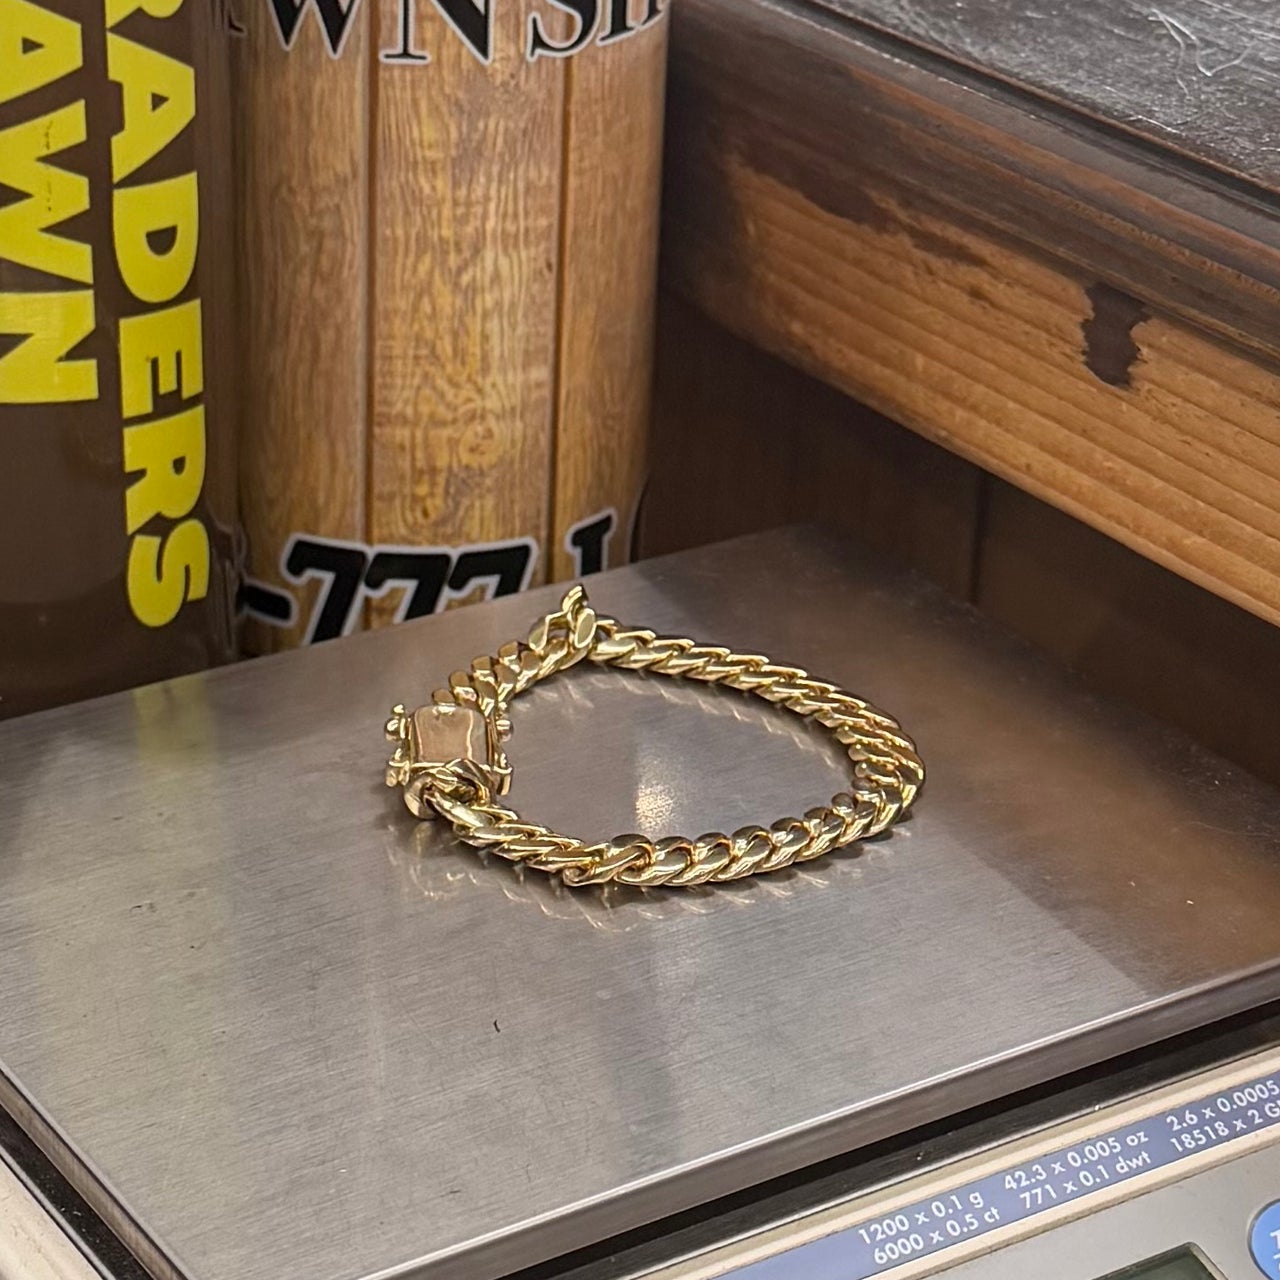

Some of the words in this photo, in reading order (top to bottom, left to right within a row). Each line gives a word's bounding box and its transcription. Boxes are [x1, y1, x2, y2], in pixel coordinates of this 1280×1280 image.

[858, 1214, 910, 1245] 1200
[915, 1211, 930, 1225] x
[931, 1195, 963, 1218] 0.1
[969, 1191, 984, 1208] g
[1004, 1164, 1047, 1191] 42.3
[1051, 1162, 1066, 1175] x
[1067, 1140, 1121, 1167] 0.005
[1126, 1130, 1149, 1146] oz
[1166, 1110, 1198, 1132] 2.6
[1202, 1106, 1216, 1119] x
[1217, 1080, 1280, 1113] 0.0005
[874, 1234, 924, 1265] 6000
[930, 1231, 944, 1244] x
[946, 1214, 979, 1237] 0.5
[984, 1207, 1001, 1223] ct
[1020, 1186, 1058, 1209] 771
[1063, 1181, 1078, 1195] x
[1079, 1165, 1110, 1188] 0.1
[1115, 1150, 1151, 1175] dwt
[1170, 1121, 1229, 1152] 18518
[1233, 1118, 1247, 1131] x
[1248, 1109, 1263, 1125] 2
